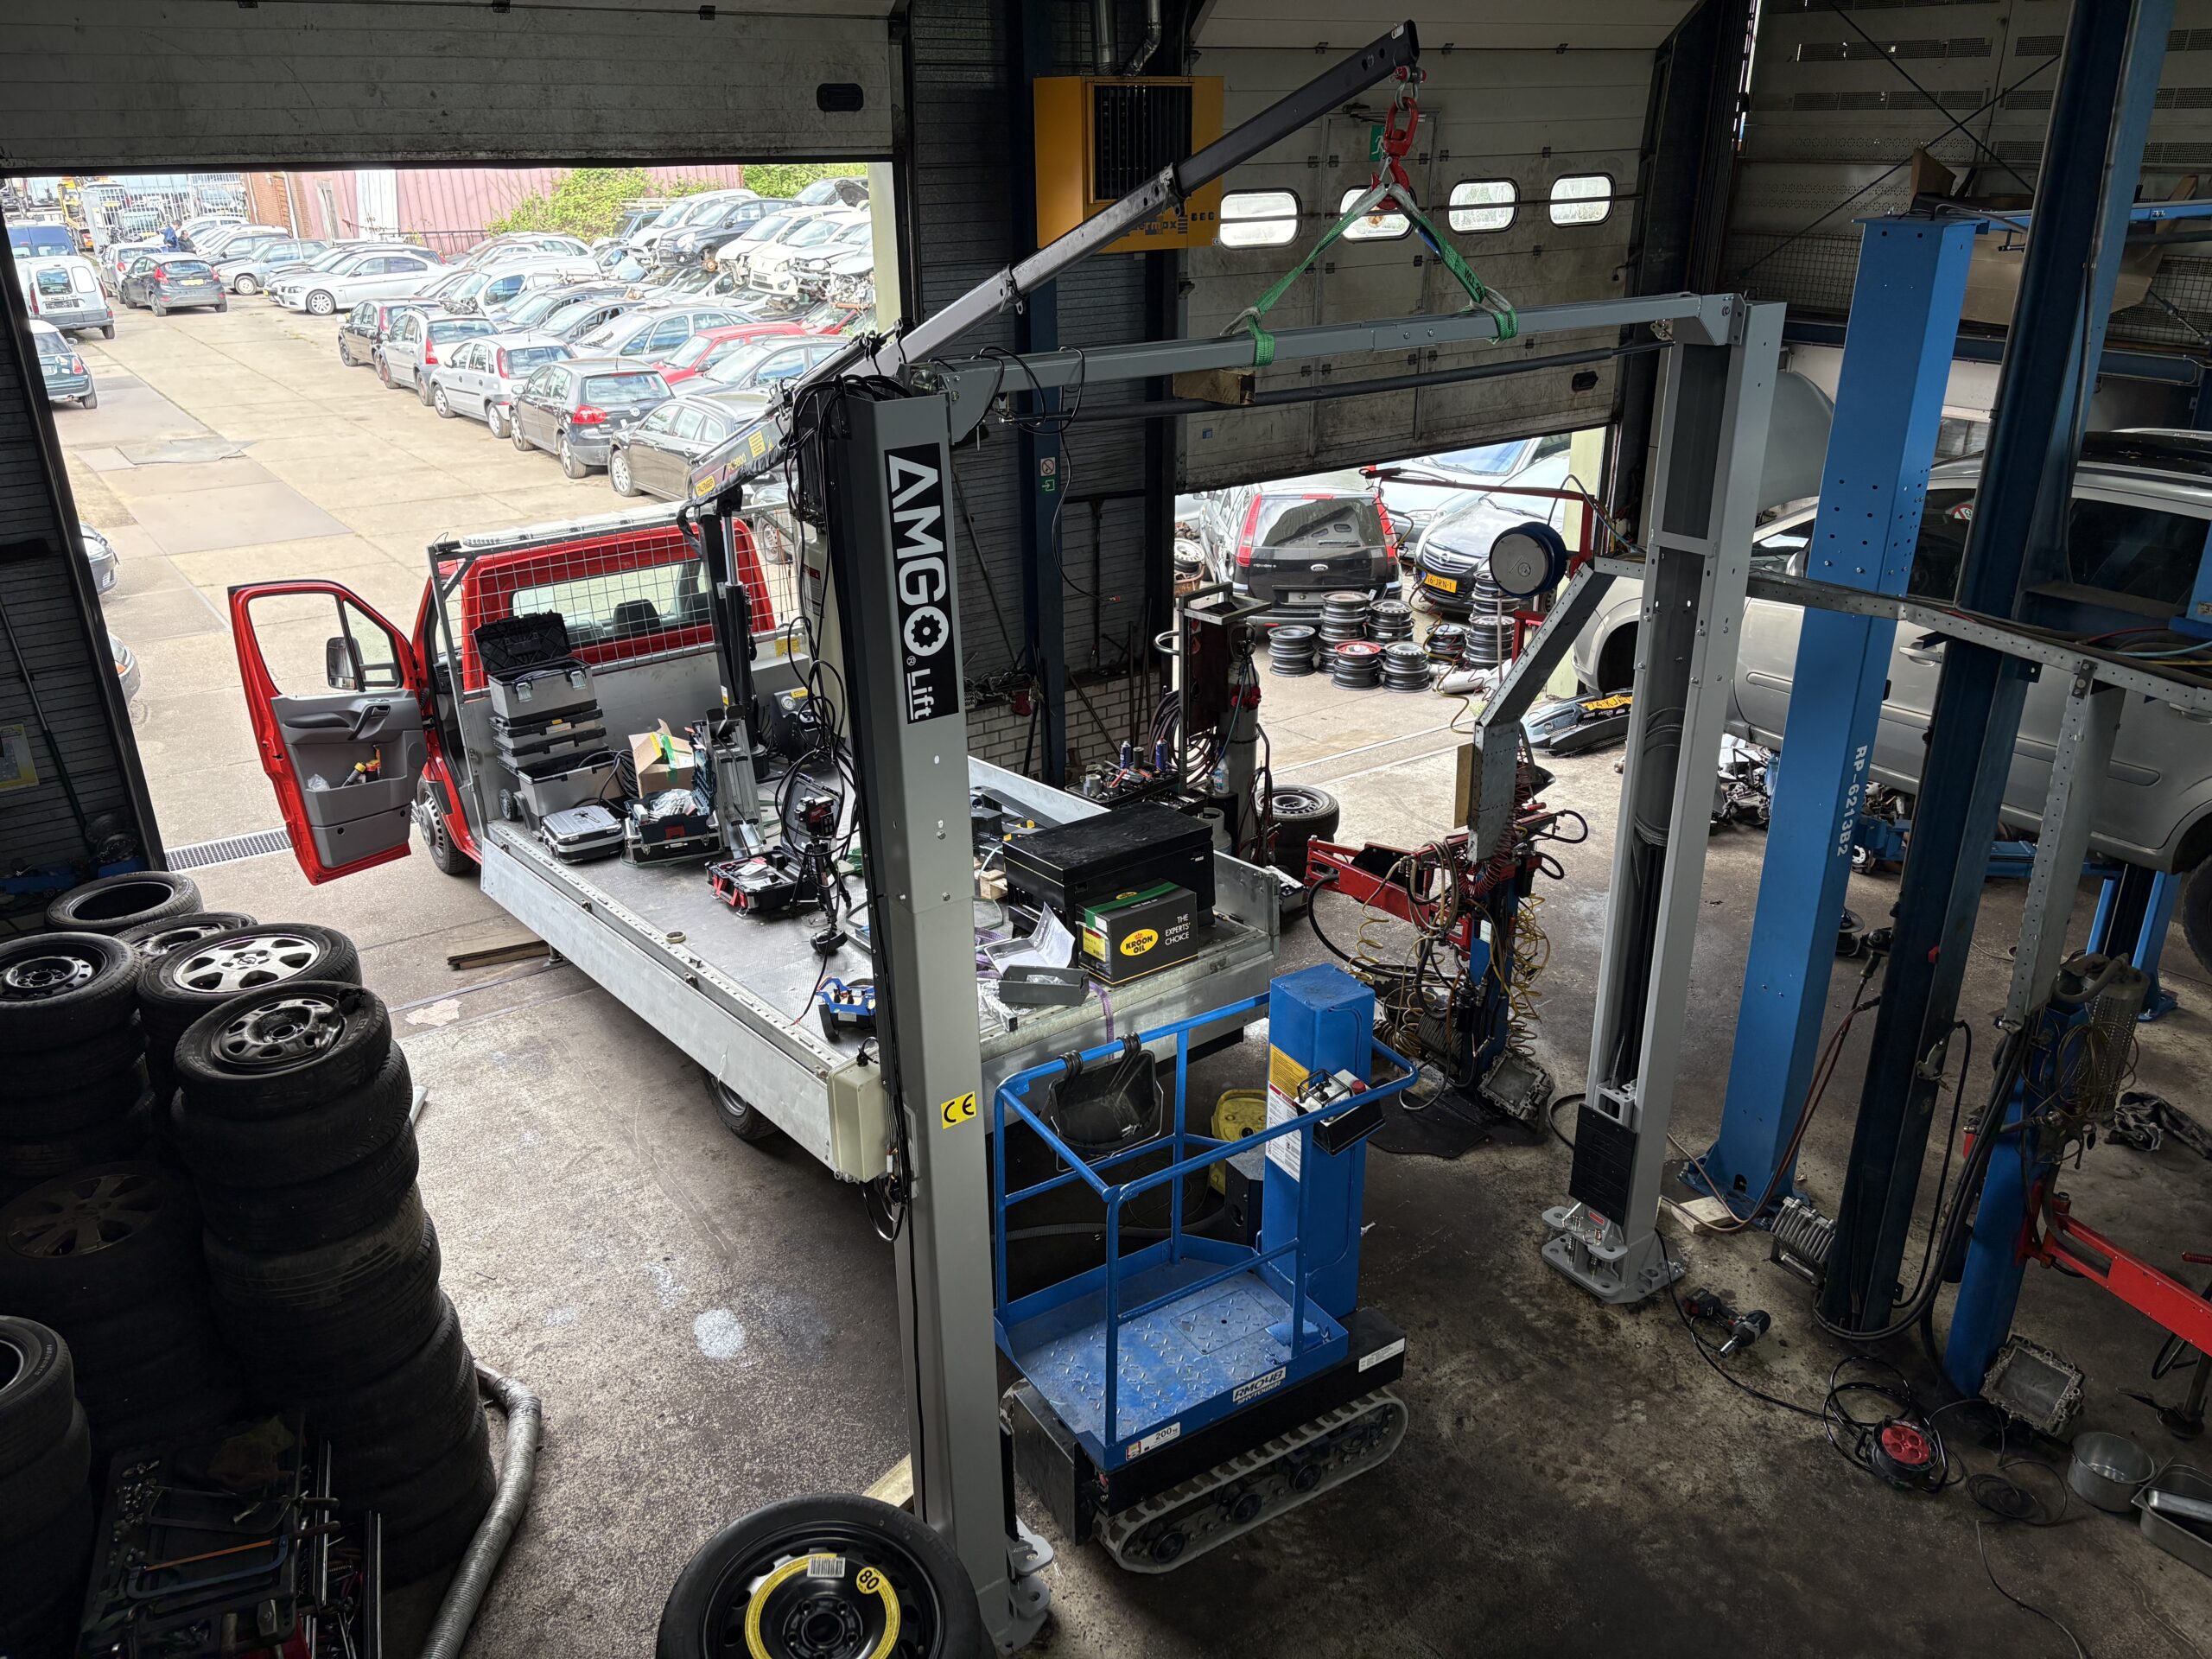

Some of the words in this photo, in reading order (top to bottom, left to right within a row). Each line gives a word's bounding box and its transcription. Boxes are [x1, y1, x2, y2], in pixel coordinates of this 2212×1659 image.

[888, 454, 949, 657] AMGO
[1427, 575, 1452, 590] 16-JRN-1
[908, 669, 932, 721] Lift
[1837, 745, 1868, 856] RP-6213B2
[1177, 913, 1189, 924] THE
[1165, 922, 1191, 937] EXPERTS'
[1126, 935, 1153, 950] KROON
[1165, 931, 1190, 945] CHOICE
[1133, 945, 1146, 954] OIL
[944, 1093, 975, 1123] CE
[1234, 1370, 1284, 1400] RM04B
[1155, 1427, 1172, 1440] 200
[859, 1569, 880, 1590] 80
